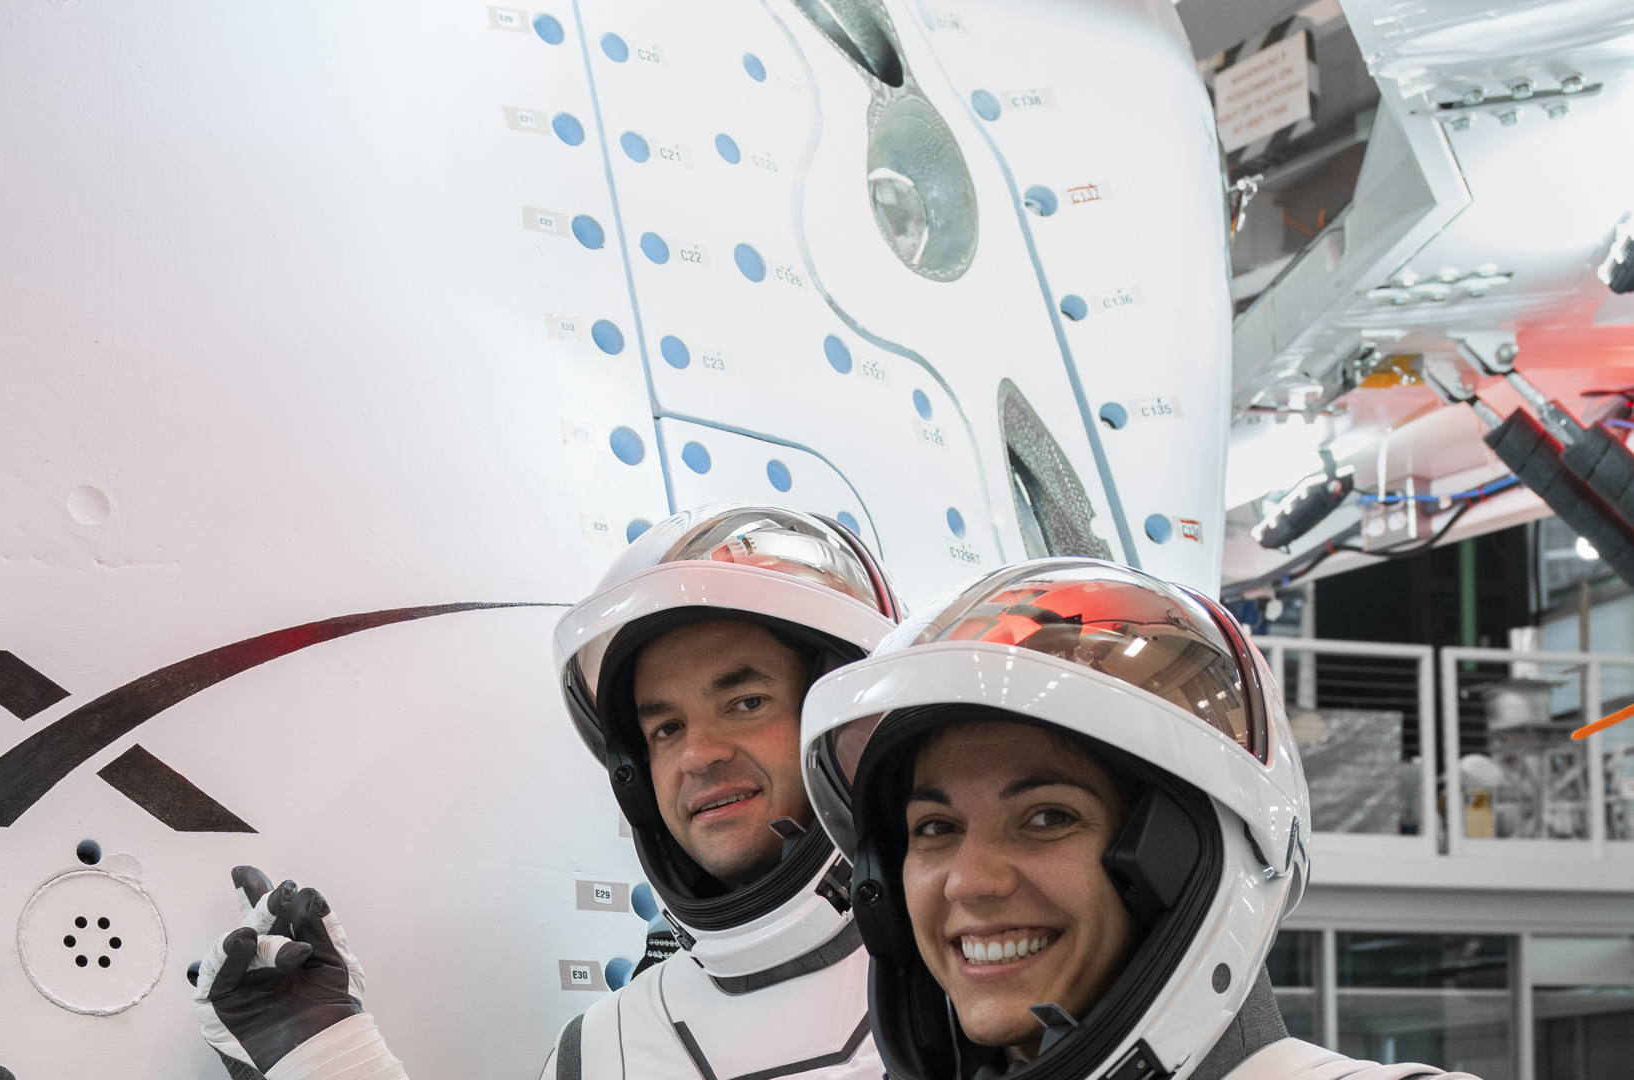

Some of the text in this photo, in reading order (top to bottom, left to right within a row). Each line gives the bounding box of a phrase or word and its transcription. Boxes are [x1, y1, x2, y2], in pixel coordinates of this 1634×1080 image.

[638, 49, 659, 64] C20
[1012, 95, 1042, 108] C138
[660, 147, 681, 162] C21
[752, 155, 778, 173] C125
[539, 217, 553, 227] E22
[680, 249, 703, 264] C22
[776, 266, 803, 287] C126
[1103, 295, 1134, 308] C136
[561, 322, 575, 332] E23
[702, 356, 725, 371] C23
[862, 362, 885, 381] C127
[1141, 405, 1172, 418] C135
[923, 428, 945, 446] C128
[593, 522, 609, 532] E25
[950, 546, 981, 565] C129RT
[595, 889, 610, 899] E29
[572, 971, 587, 980] E30
